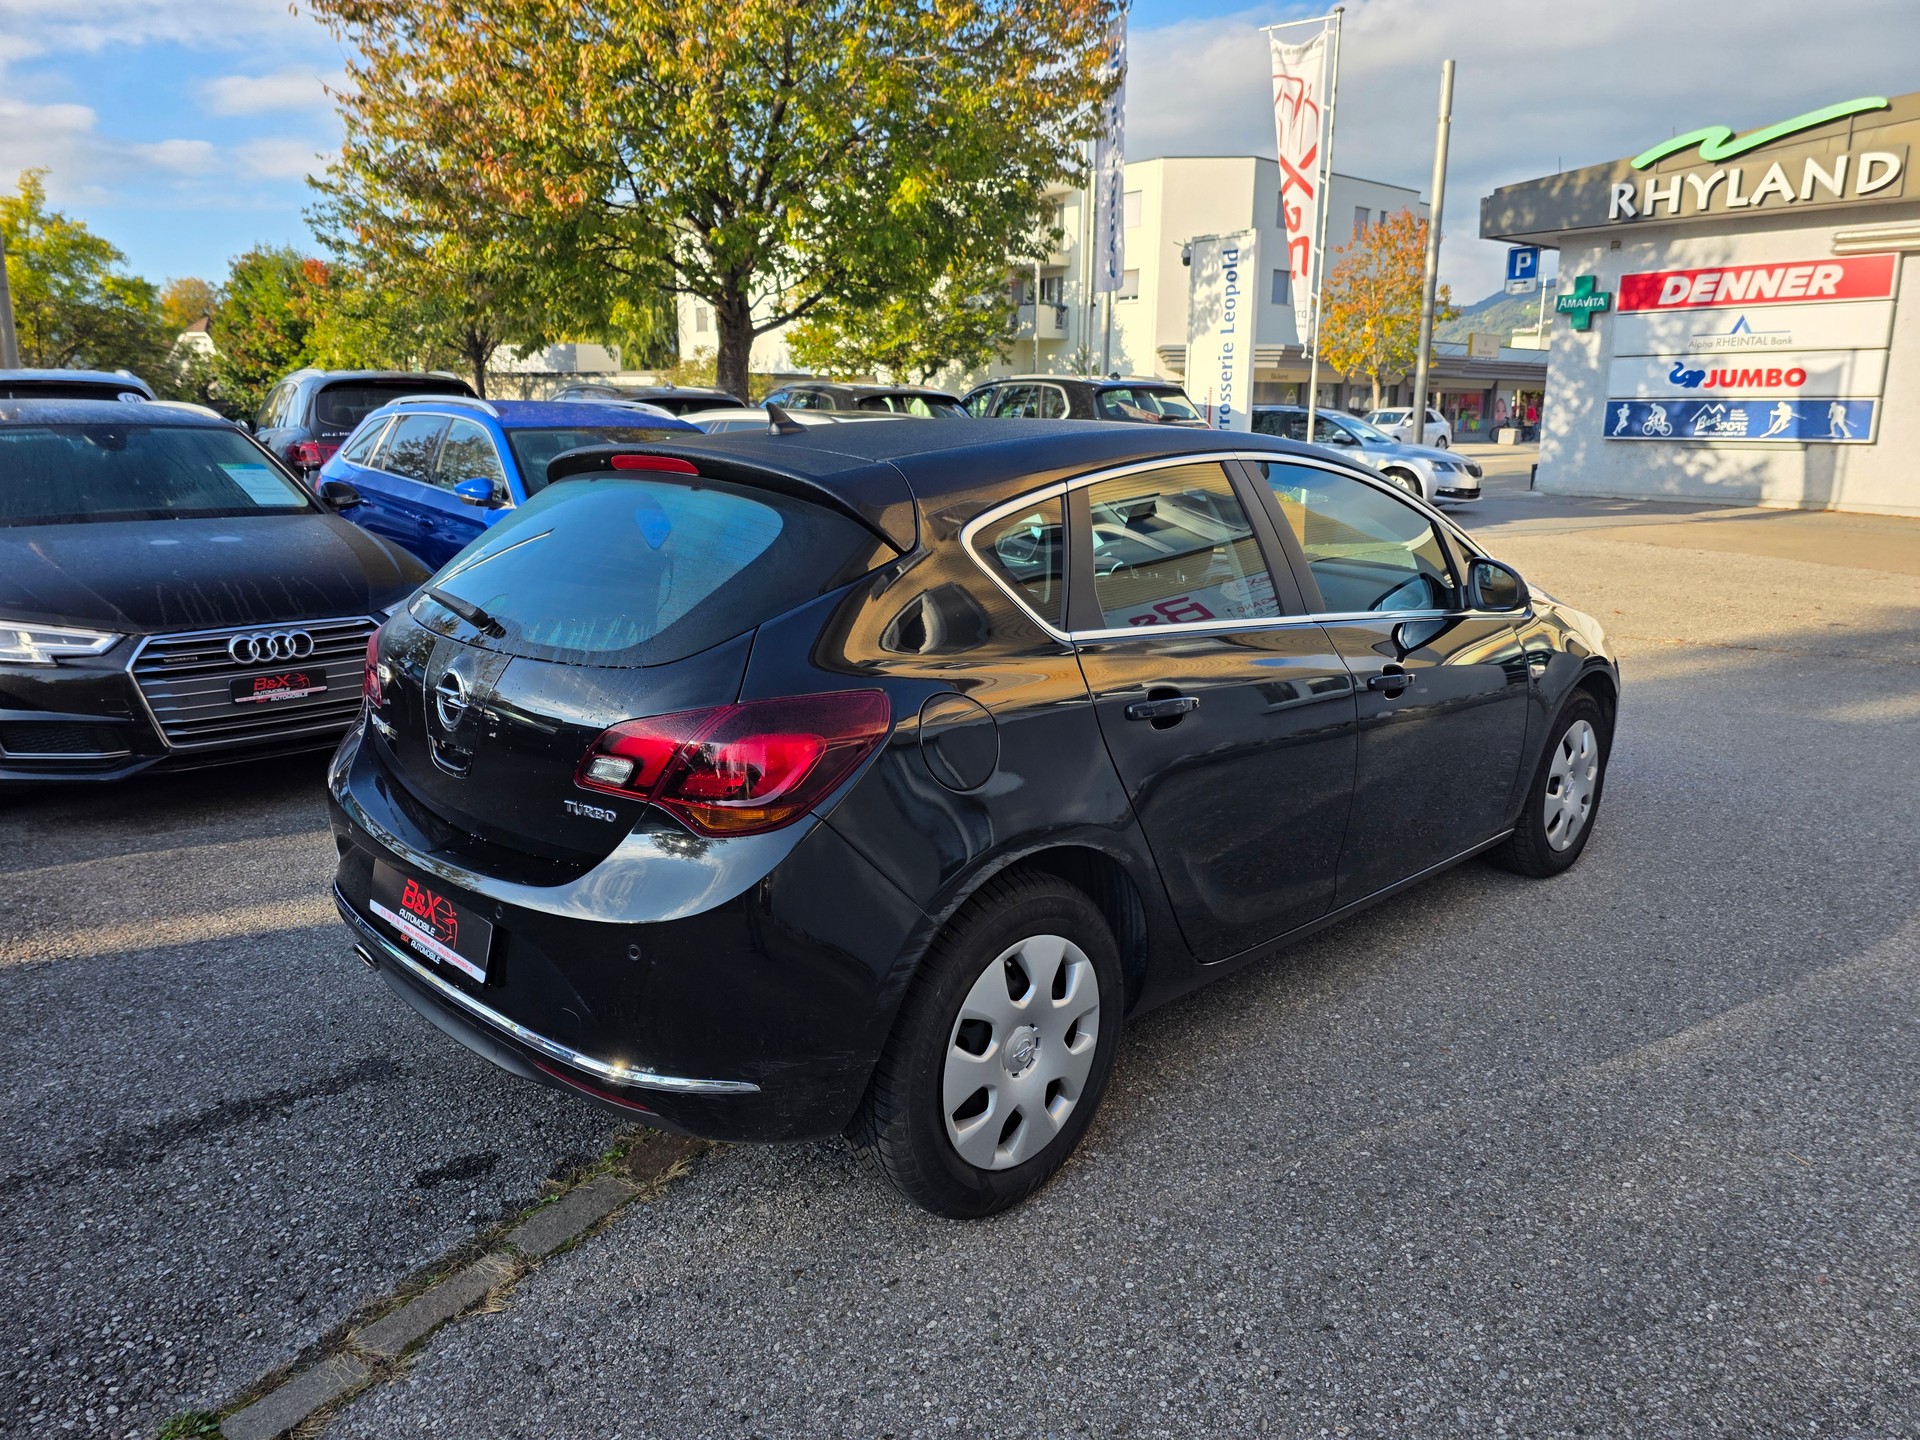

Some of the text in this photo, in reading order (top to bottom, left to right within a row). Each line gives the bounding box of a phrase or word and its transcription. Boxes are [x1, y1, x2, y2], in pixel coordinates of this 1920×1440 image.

[1608, 152, 1901, 219] RHYLAND
[1515, 252, 1531, 276] P
[1220, 249, 1240, 334] Leopold
[1657, 264, 1844, 305] DENNER
[1558, 296, 1604, 310] AMAVITA
[1688, 336, 1793, 349] Alpha RHEINTAL Bank
[1703, 368, 1807, 388] JUMBO
[253, 674, 290, 691] B&X
[564, 800, 617, 822] TURBO
[402, 879, 442, 925] B&X
[399, 908, 436, 937] AUTOMOBILE
[411, 940, 441, 965] AUTOMOBILE
